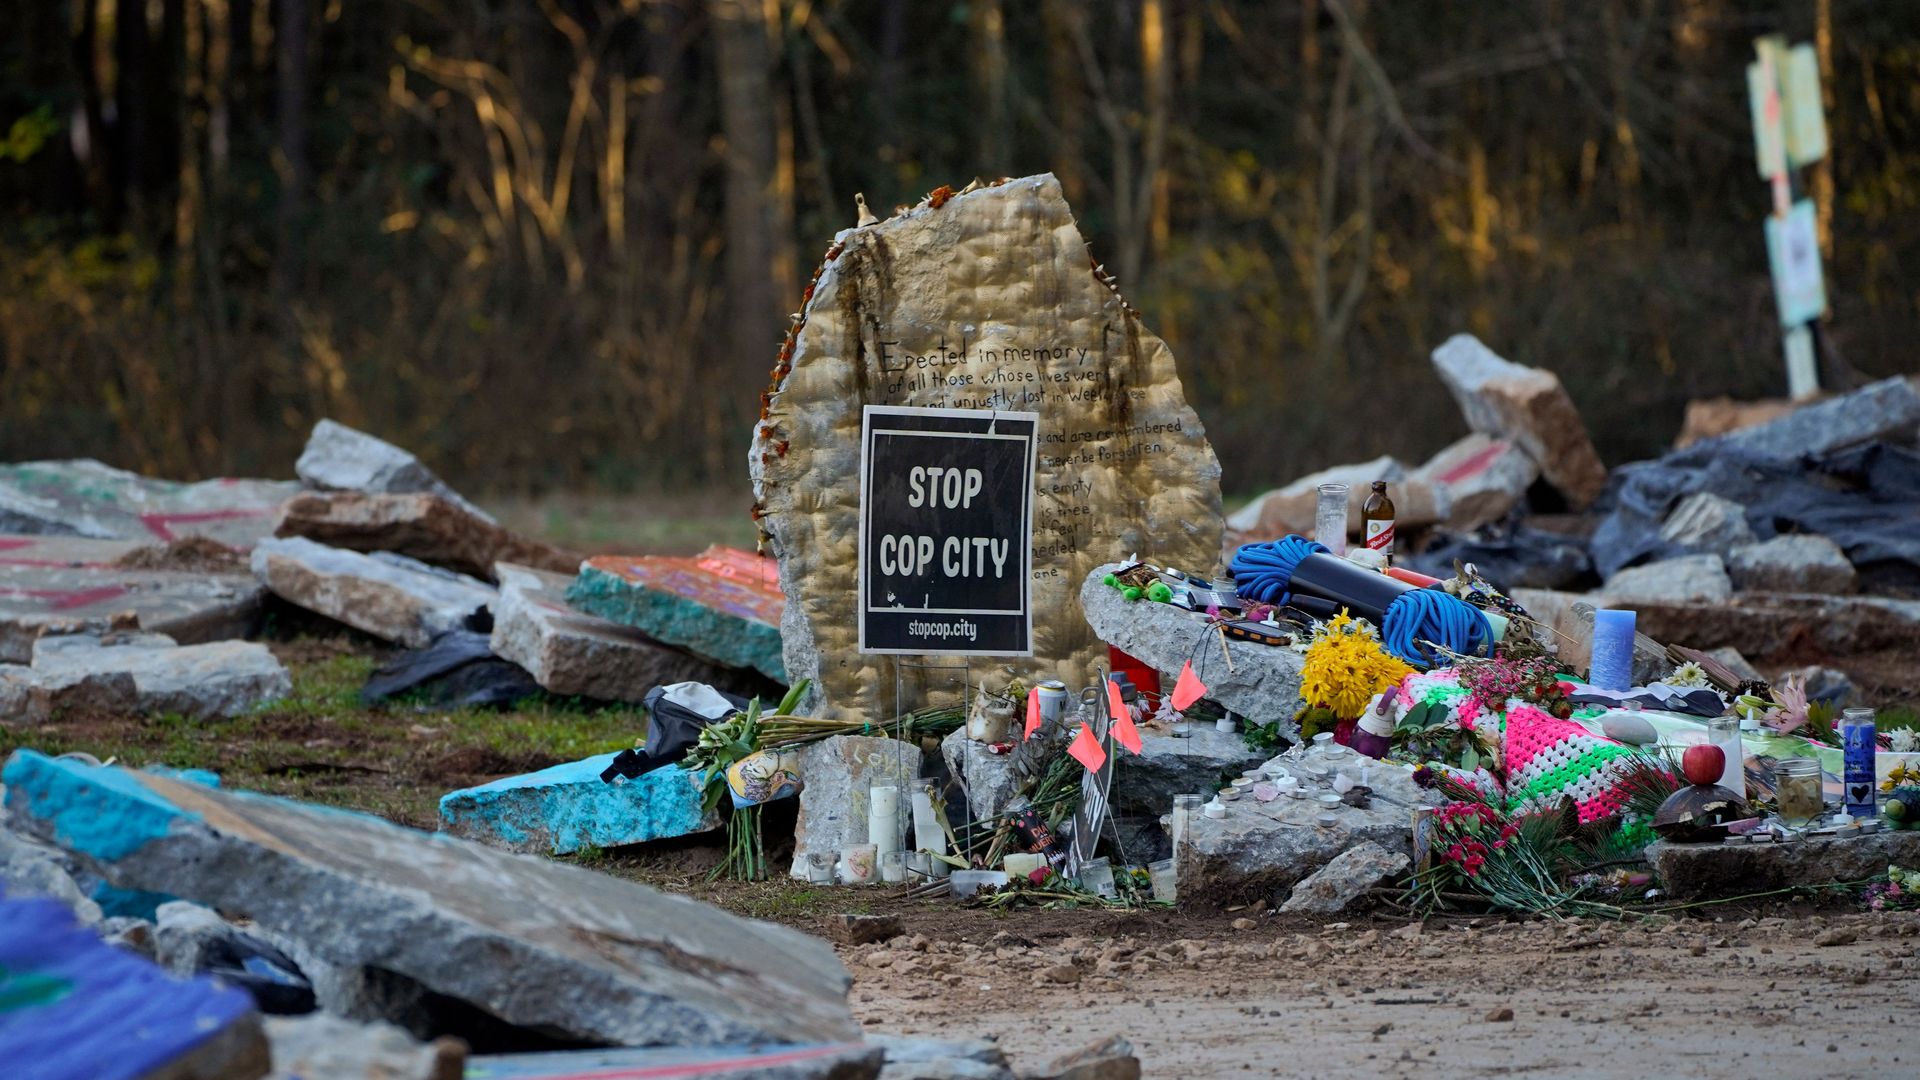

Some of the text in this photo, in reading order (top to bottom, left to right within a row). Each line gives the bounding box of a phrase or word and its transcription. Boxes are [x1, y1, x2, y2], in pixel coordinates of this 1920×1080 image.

[979, 348, 998, 363] in
[1003, 346, 1088, 366] memory
[888, 366, 1108, 393] of all those whose lives wer
[953, 388, 1017, 411] unjustly
[1023, 385, 1046, 403] lost
[1053, 393, 1063, 403] in
[1046, 428, 1066, 443] and
[1071, 431, 1092, 443] are
[1048, 455, 1081, 468] never
[1081, 449, 1095, 464] be
[908, 465, 983, 509] STOP
[1053, 477, 1092, 498] empty
[1041, 505, 1052, 518] is
[880, 534, 1009, 579] COP CITY
[909, 618, 977, 642] stopcop.city
